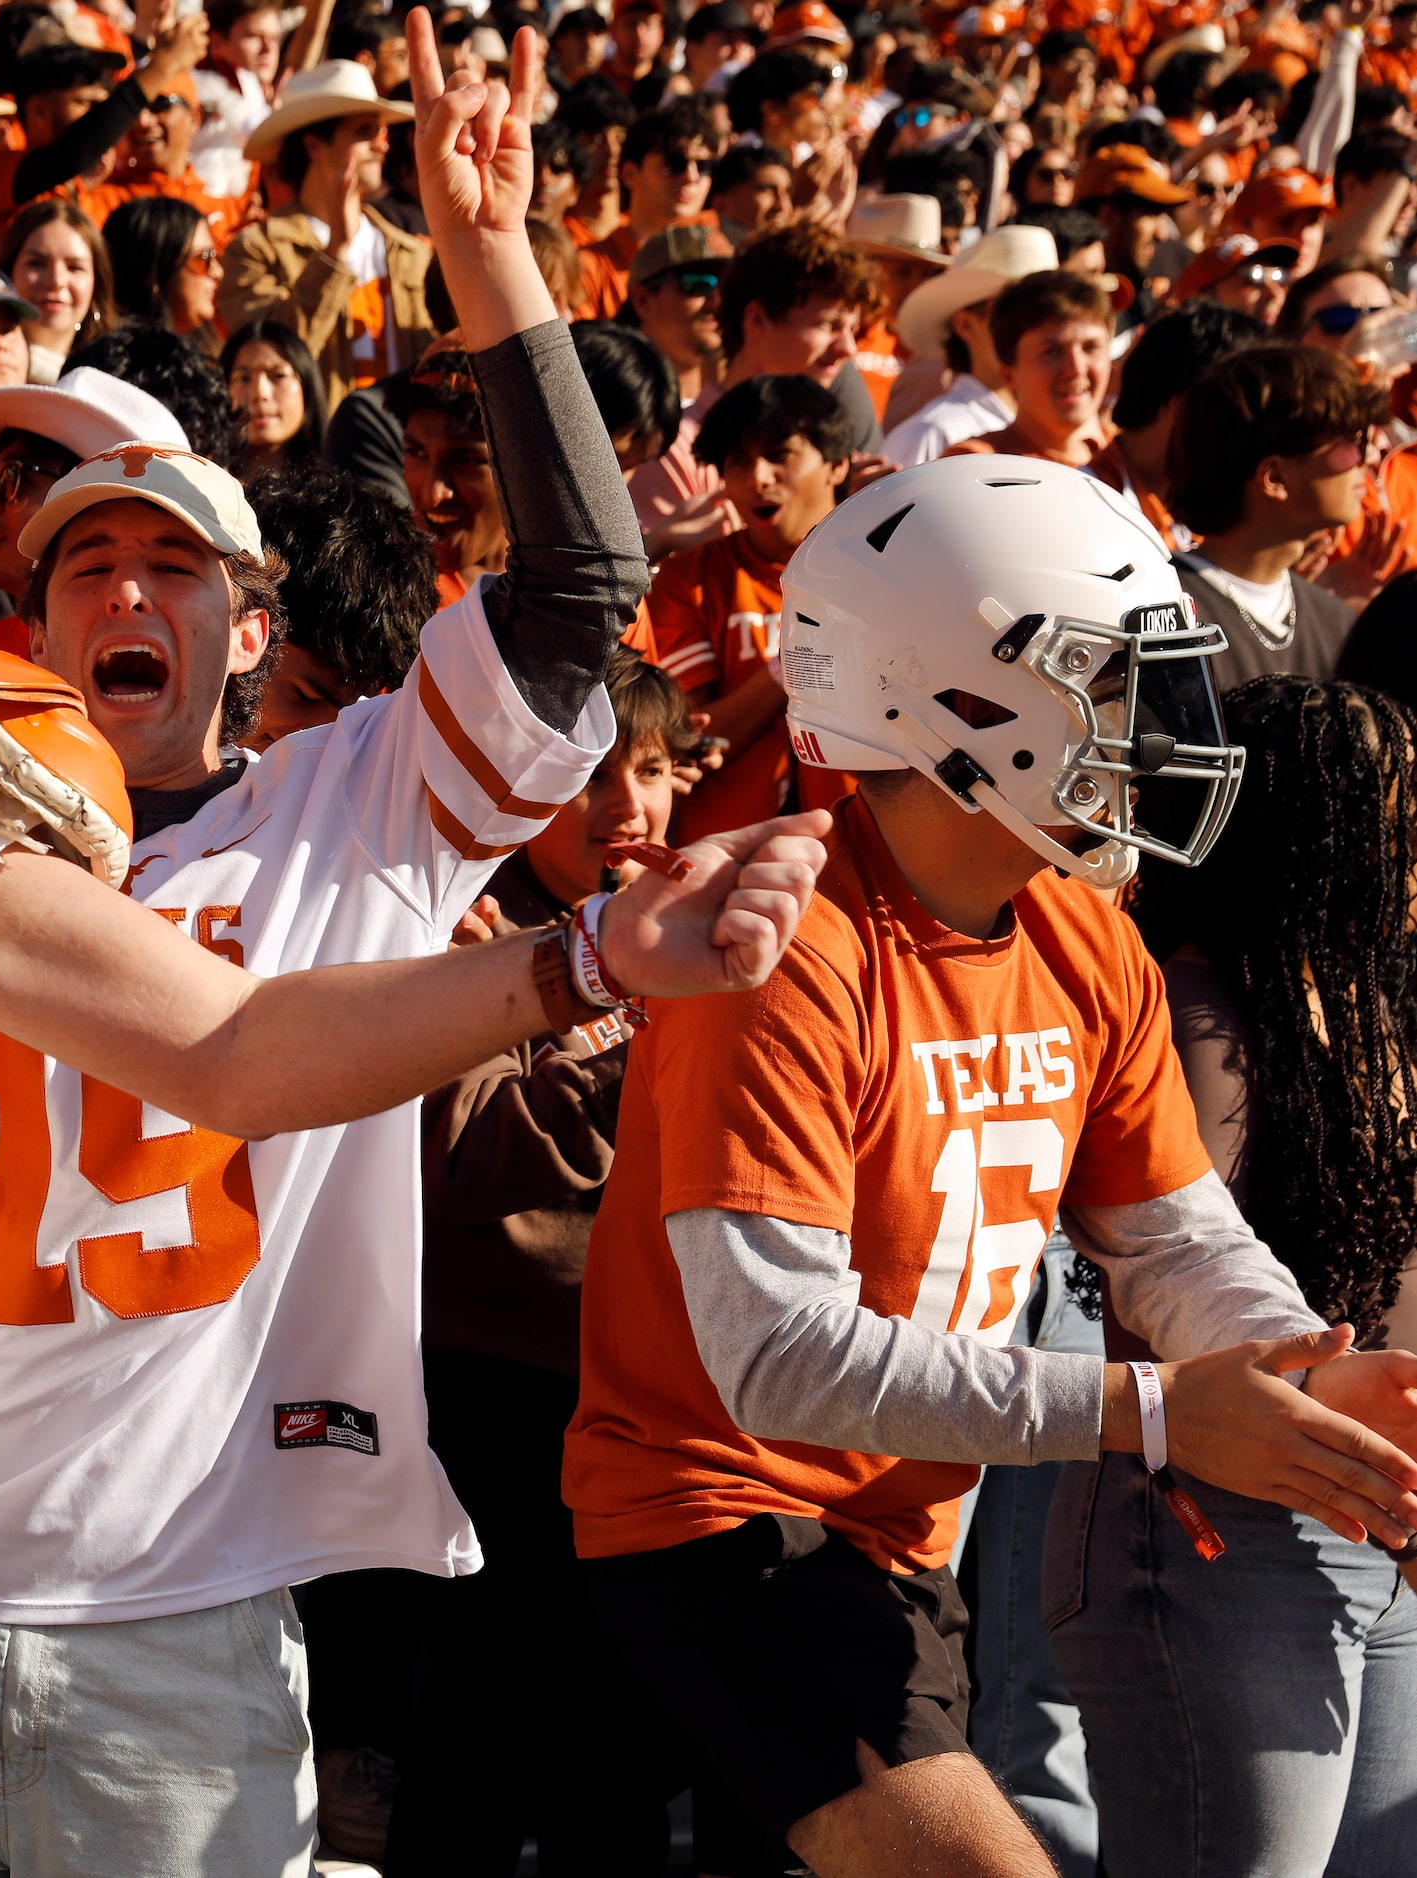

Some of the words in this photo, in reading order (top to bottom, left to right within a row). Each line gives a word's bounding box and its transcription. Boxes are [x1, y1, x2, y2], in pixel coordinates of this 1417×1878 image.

[794, 645, 814, 654] WARNING
[910, 1026, 1076, 1115] TEXAS
[909, 1117, 1065, 1348] 16
[284, 1404, 321, 1412] TEAM
[287, 1413, 317, 1425] NIKE
[341, 1411, 360, 1430] XL
[282, 1437, 324, 1445] SPORTS
